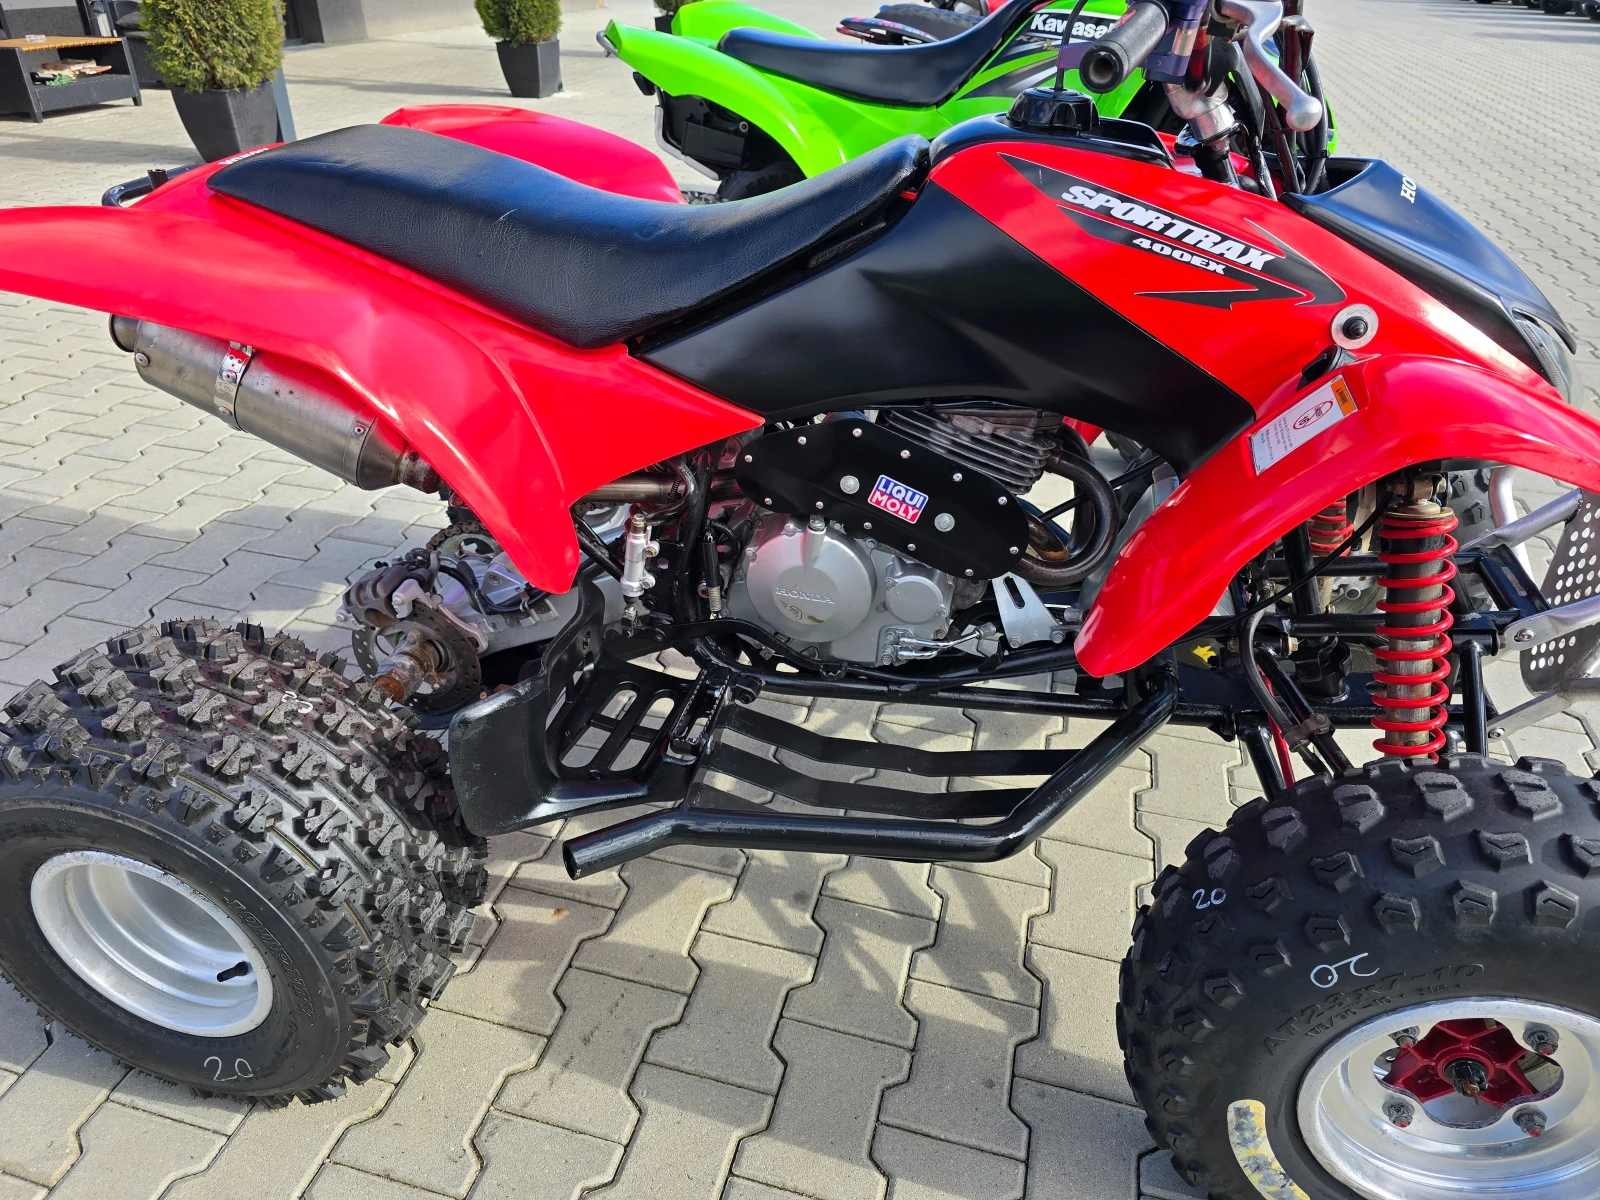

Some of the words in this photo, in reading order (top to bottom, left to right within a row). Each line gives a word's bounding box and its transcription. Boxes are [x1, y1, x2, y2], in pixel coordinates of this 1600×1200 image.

[1400, 172, 1417, 204] HO
[1061, 185, 1277, 271] SPORTRAX
[1132, 237, 1227, 275] 400EX
[871, 490, 919, 520] MOLY
[877, 477, 925, 509] LIQUI
[775, 586, 836, 605] HONDA
[1192, 887, 1227, 910] 20
[204, 1055, 254, 1082] 20
